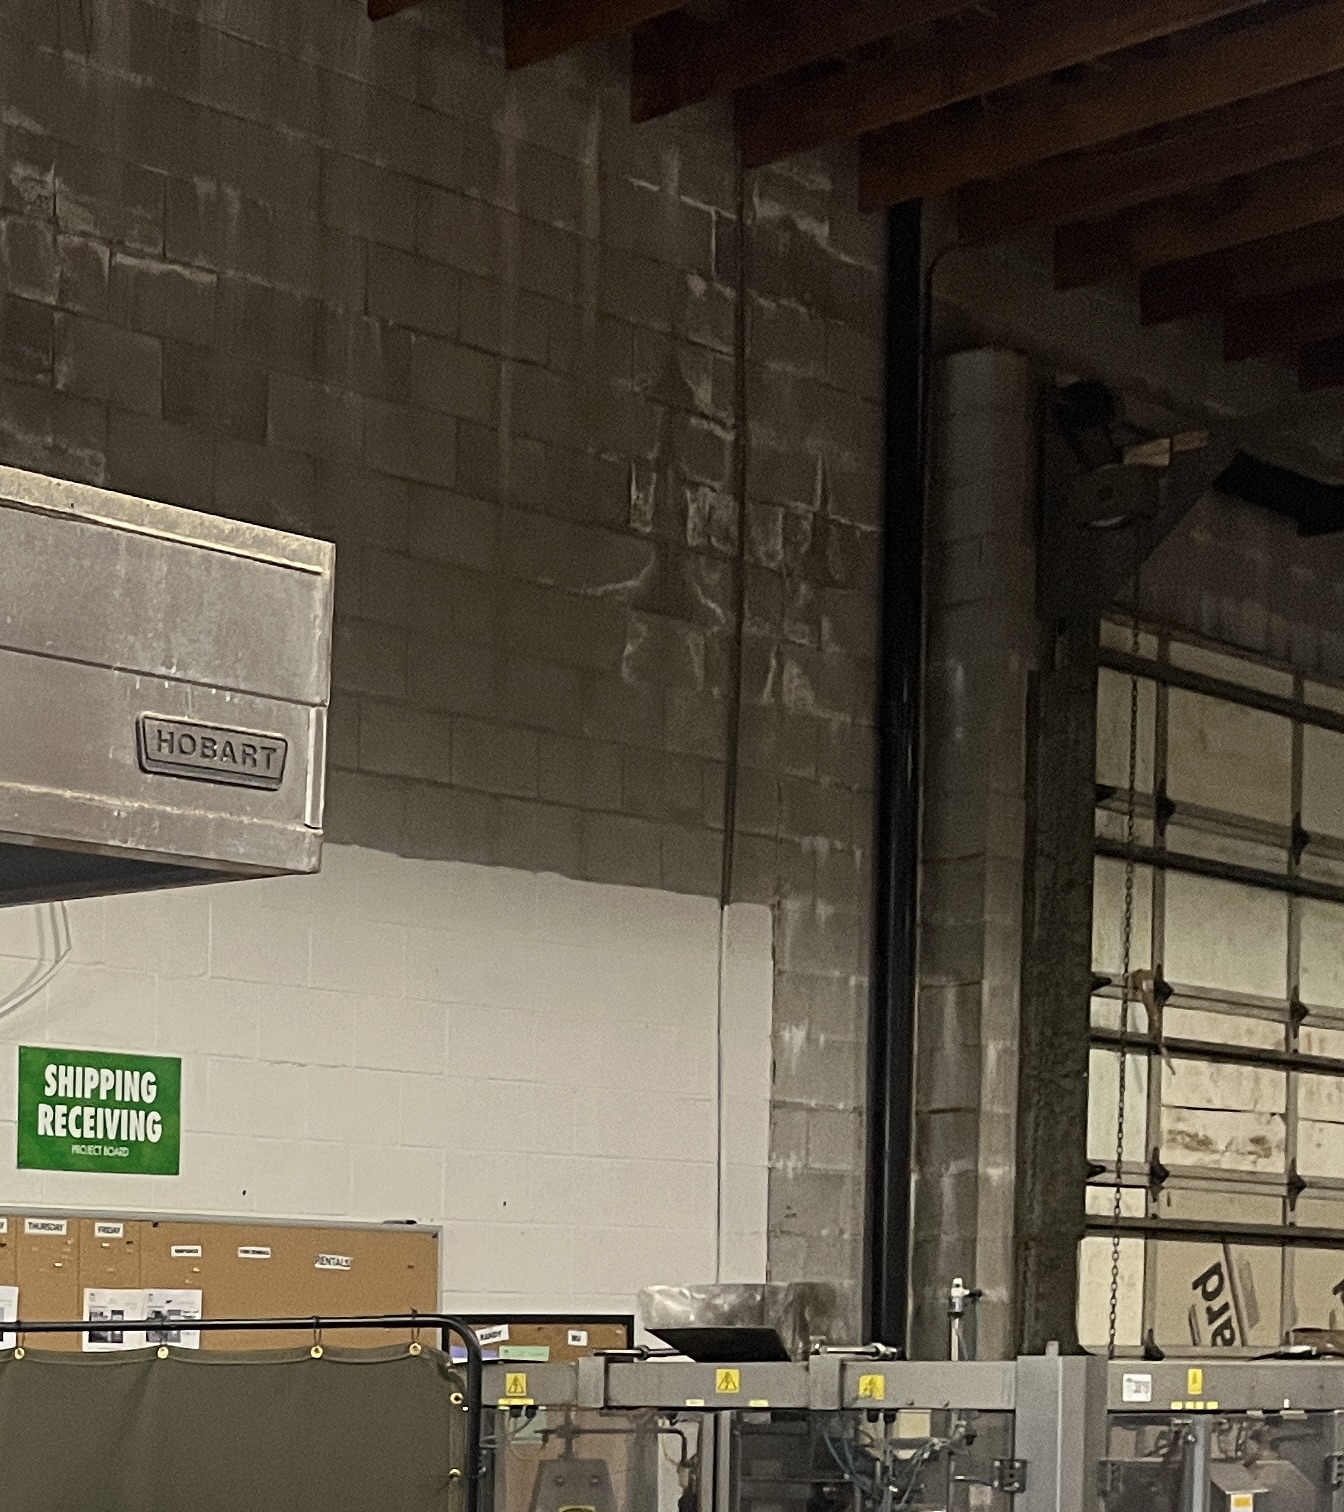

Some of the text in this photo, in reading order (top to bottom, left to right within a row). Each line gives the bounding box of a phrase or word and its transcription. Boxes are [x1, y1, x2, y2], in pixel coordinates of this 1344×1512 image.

[155, 728, 278, 771] HOBART
[44, 1063, 157, 1104] SHIPPING
[37, 1103, 162, 1143] RECEIVING
[71, 1144, 130, 1158] PROJECT BOARD
[28, 1221, 64, 1232] THURSDAY
[97, 1225, 121, 1235] FRIDAY
